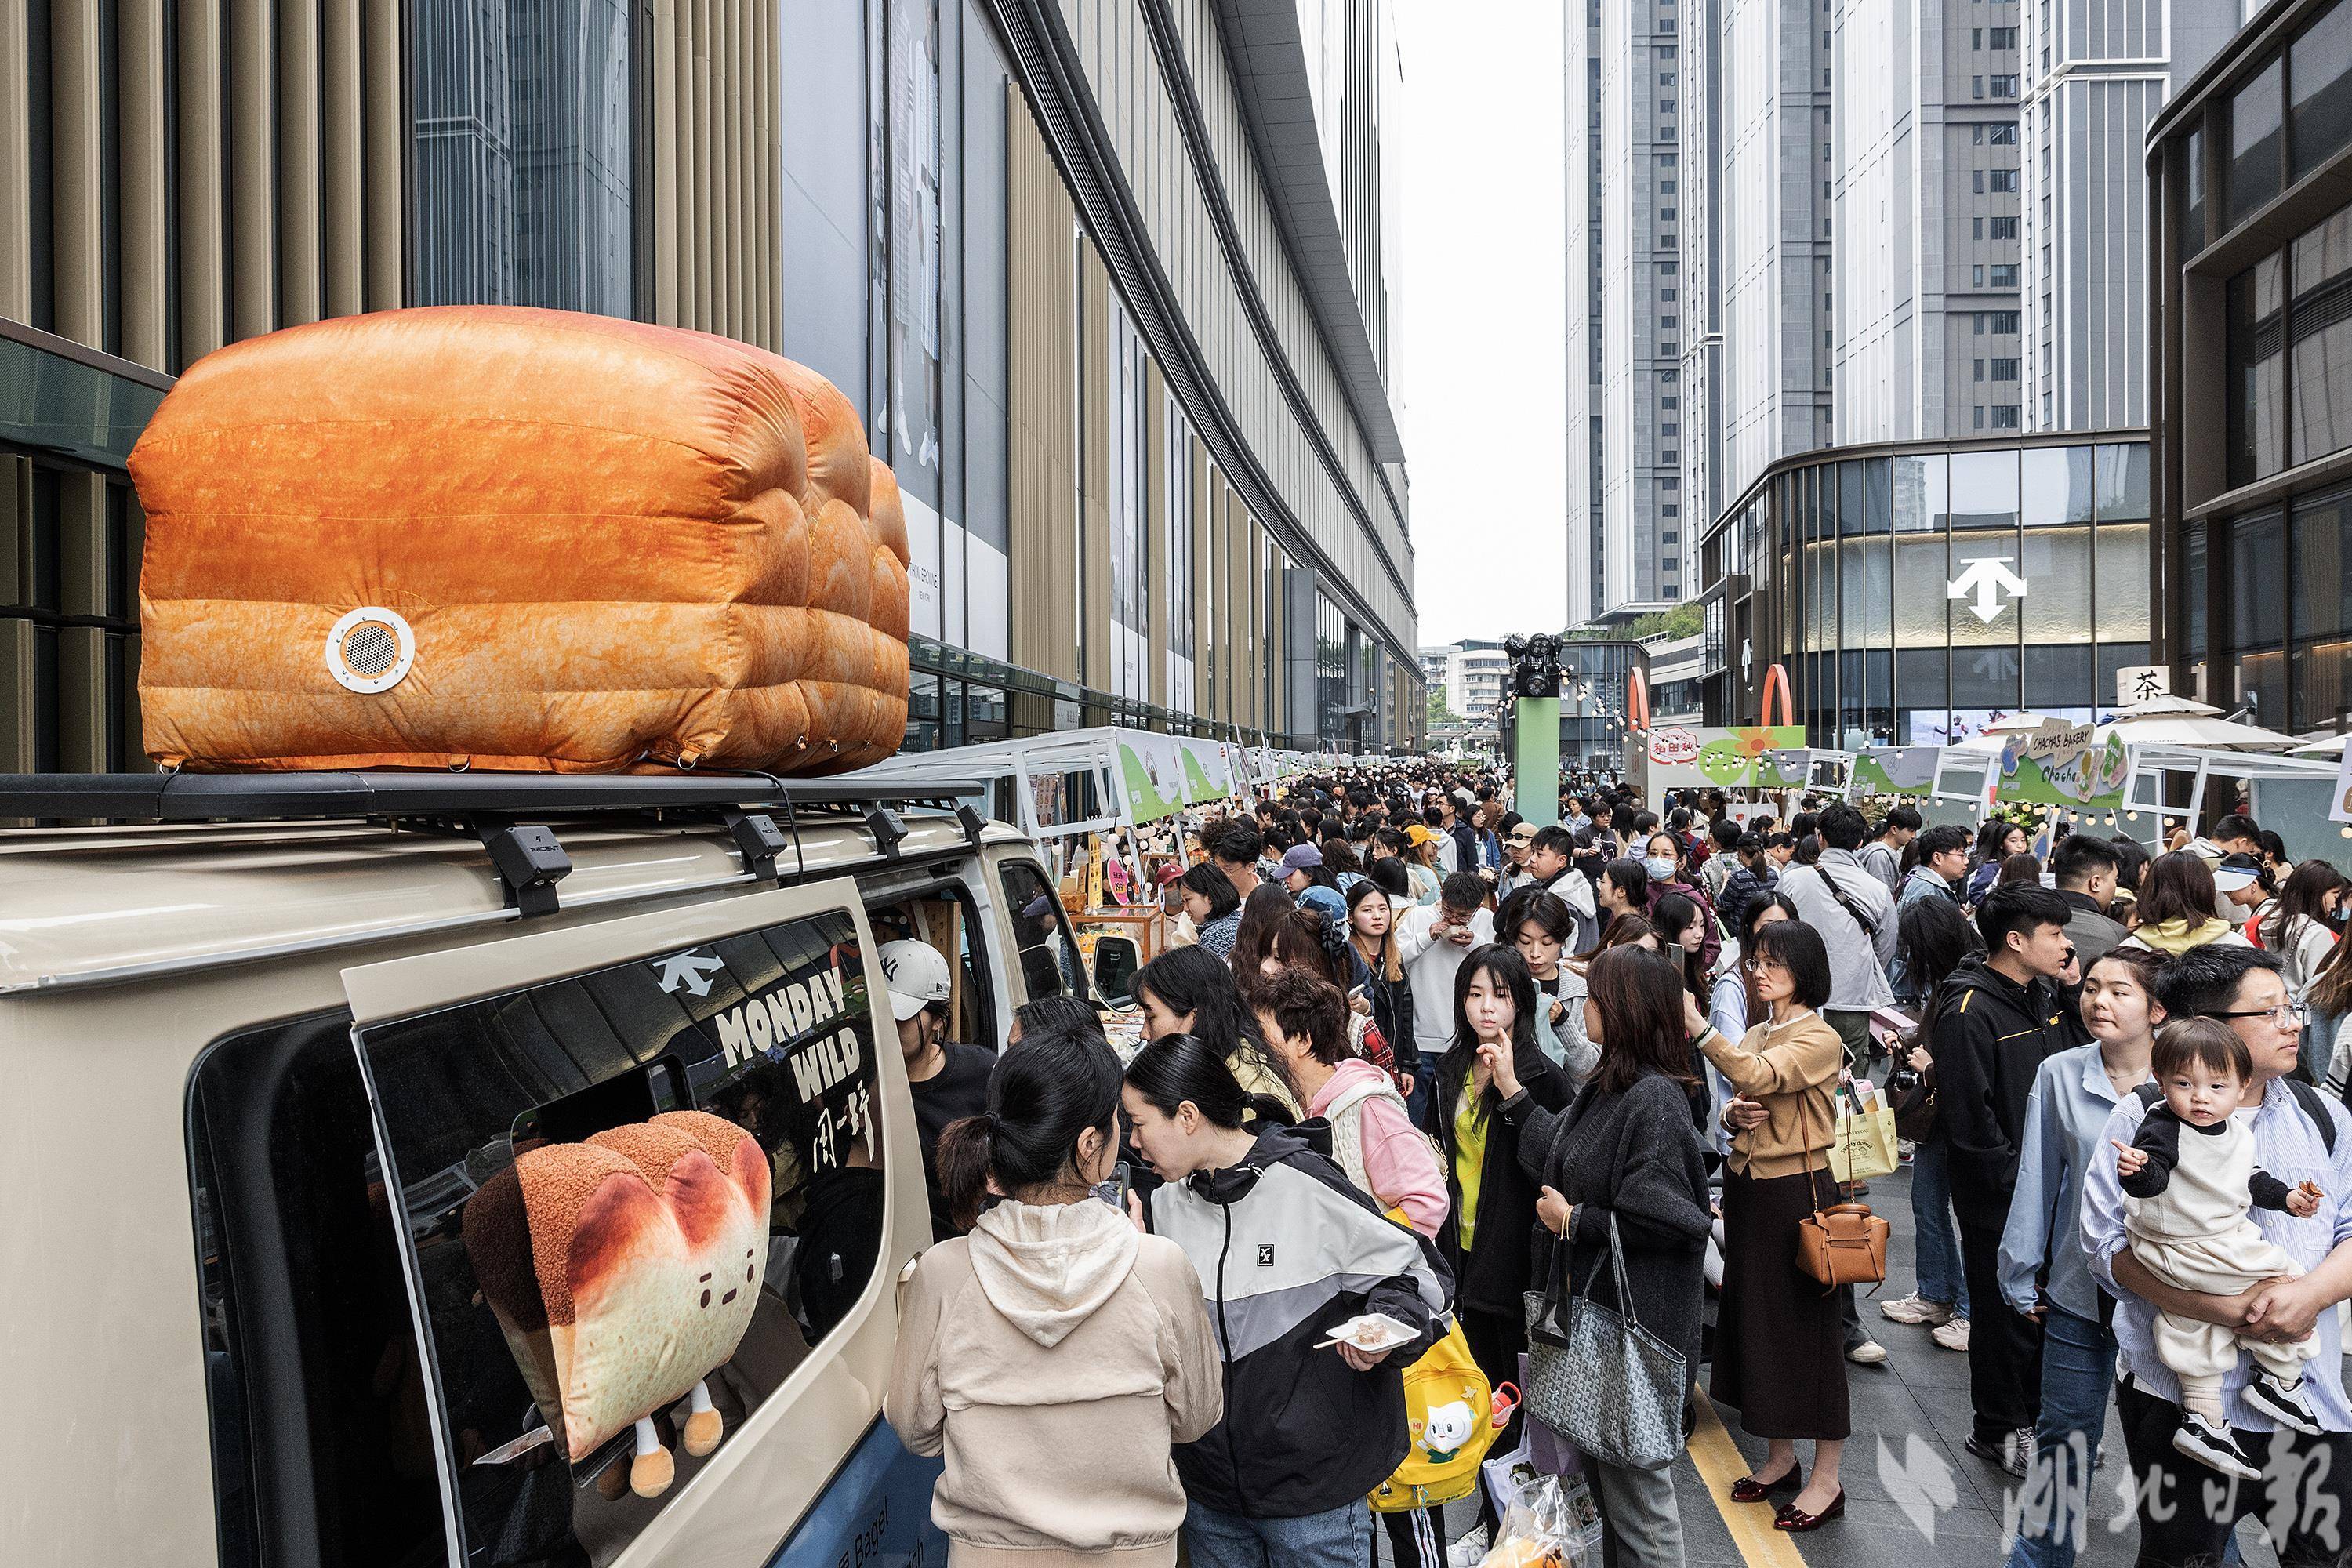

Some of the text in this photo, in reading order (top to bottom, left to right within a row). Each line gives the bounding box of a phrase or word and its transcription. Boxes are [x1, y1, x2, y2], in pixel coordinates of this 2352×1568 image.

[2133, 670, 2163, 701] 茶
[2063, 730, 2089, 748] BAKERY
[714, 966, 845, 1069] MONDAY
[789, 1026, 861, 1104] WILD
[855, 1495, 889, 1568] Bagel
